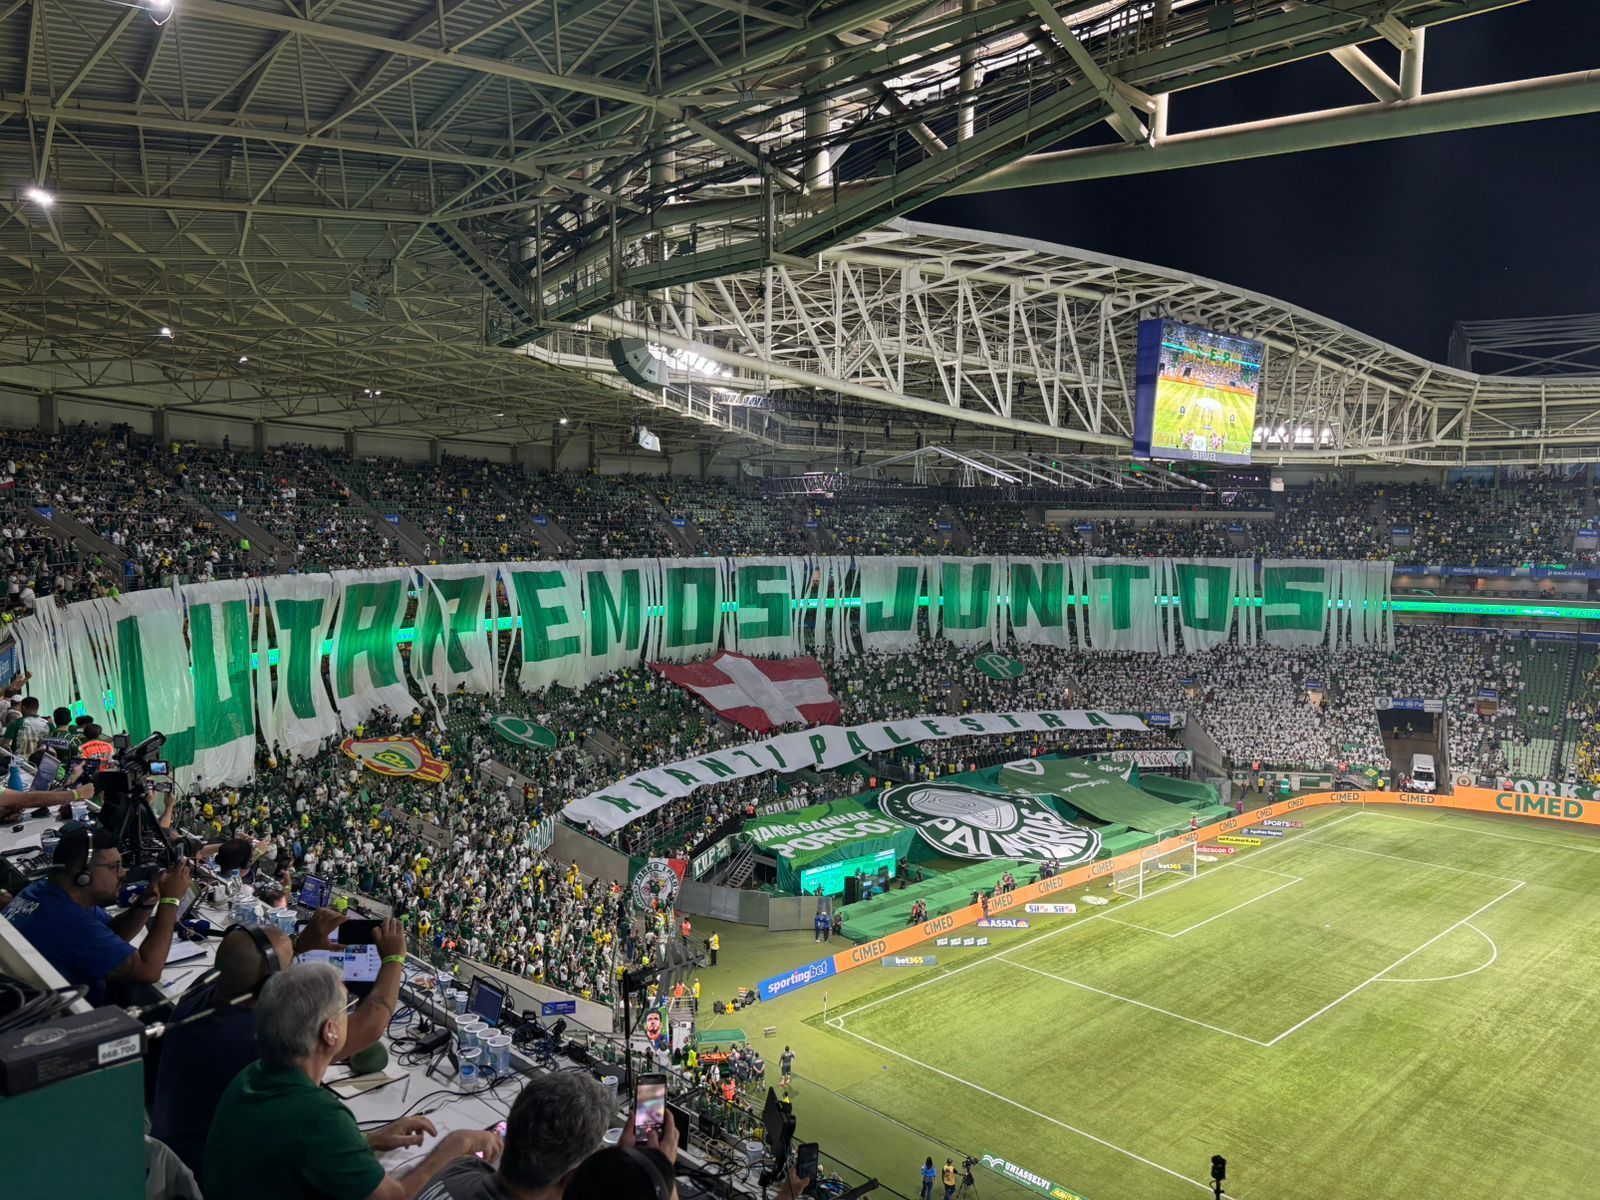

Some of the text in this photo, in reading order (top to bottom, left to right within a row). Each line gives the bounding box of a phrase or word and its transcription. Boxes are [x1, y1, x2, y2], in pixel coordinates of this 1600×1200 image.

[117, 562, 1325, 770] LUTAREMOS JUNTOS
[808, 711, 1113, 765] PALESTRA
[1287, 798, 1304, 809] CIMED
[1331, 793, 1360, 801] CIMED
[1400, 794, 1435, 804] CIMED
[1496, 793, 1584, 818] CIMED
[1256, 807, 1273, 819] CIMED
[748, 810, 875, 843] VAMOS GANHAR
[1219, 819, 1238, 832] CIMED
[770, 819, 904, 858] PORCO!
[1179, 832, 1198, 847] CIMED
[1092, 860, 1115, 876] CIMED
[1038, 877, 1063, 894] CIMED
[987, 894, 1013, 913] CIMED
[924, 915, 954, 936] CIMED
[852, 940, 887, 963] CIMED
[895, 957, 924, 965] bet365
[767, 961, 828, 994] sportingbet
[1004, 1161, 1051, 1191] UNIASSELVI
